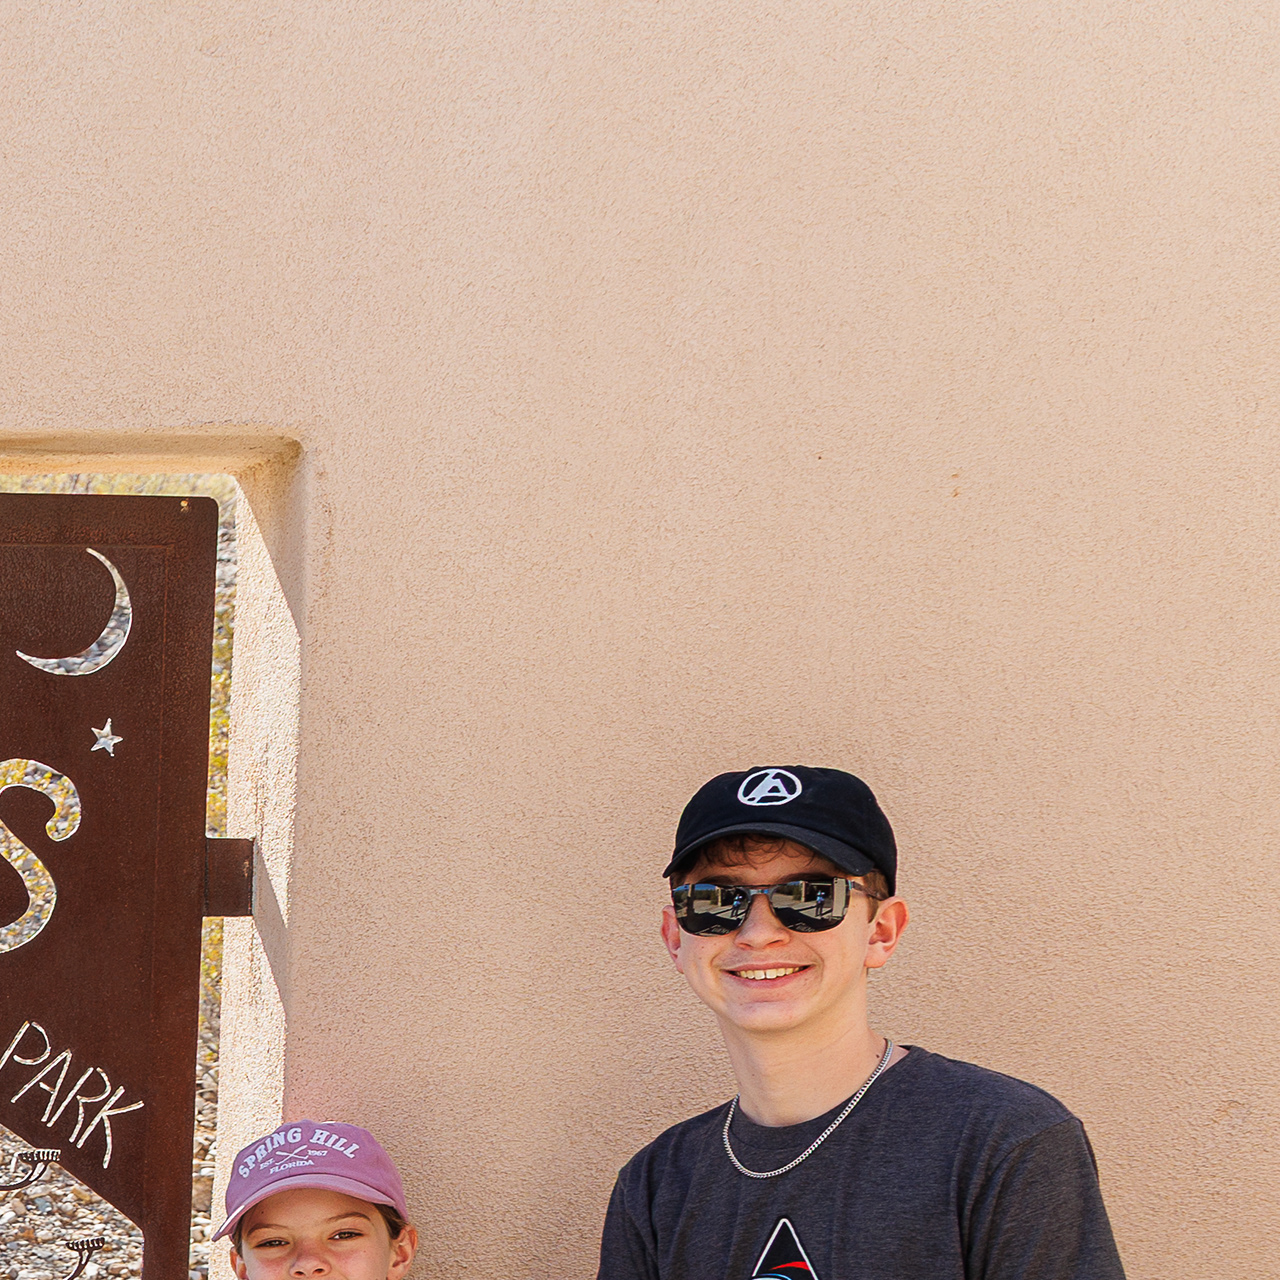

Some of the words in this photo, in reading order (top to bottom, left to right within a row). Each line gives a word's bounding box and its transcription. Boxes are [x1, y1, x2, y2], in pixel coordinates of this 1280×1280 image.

[238, 1127, 302, 1178] SPRING
[309, 1129, 360, 1160] HILL
[307, 1149, 328, 1157] 1967
[269, 1159, 315, 1175] FLORIDA
